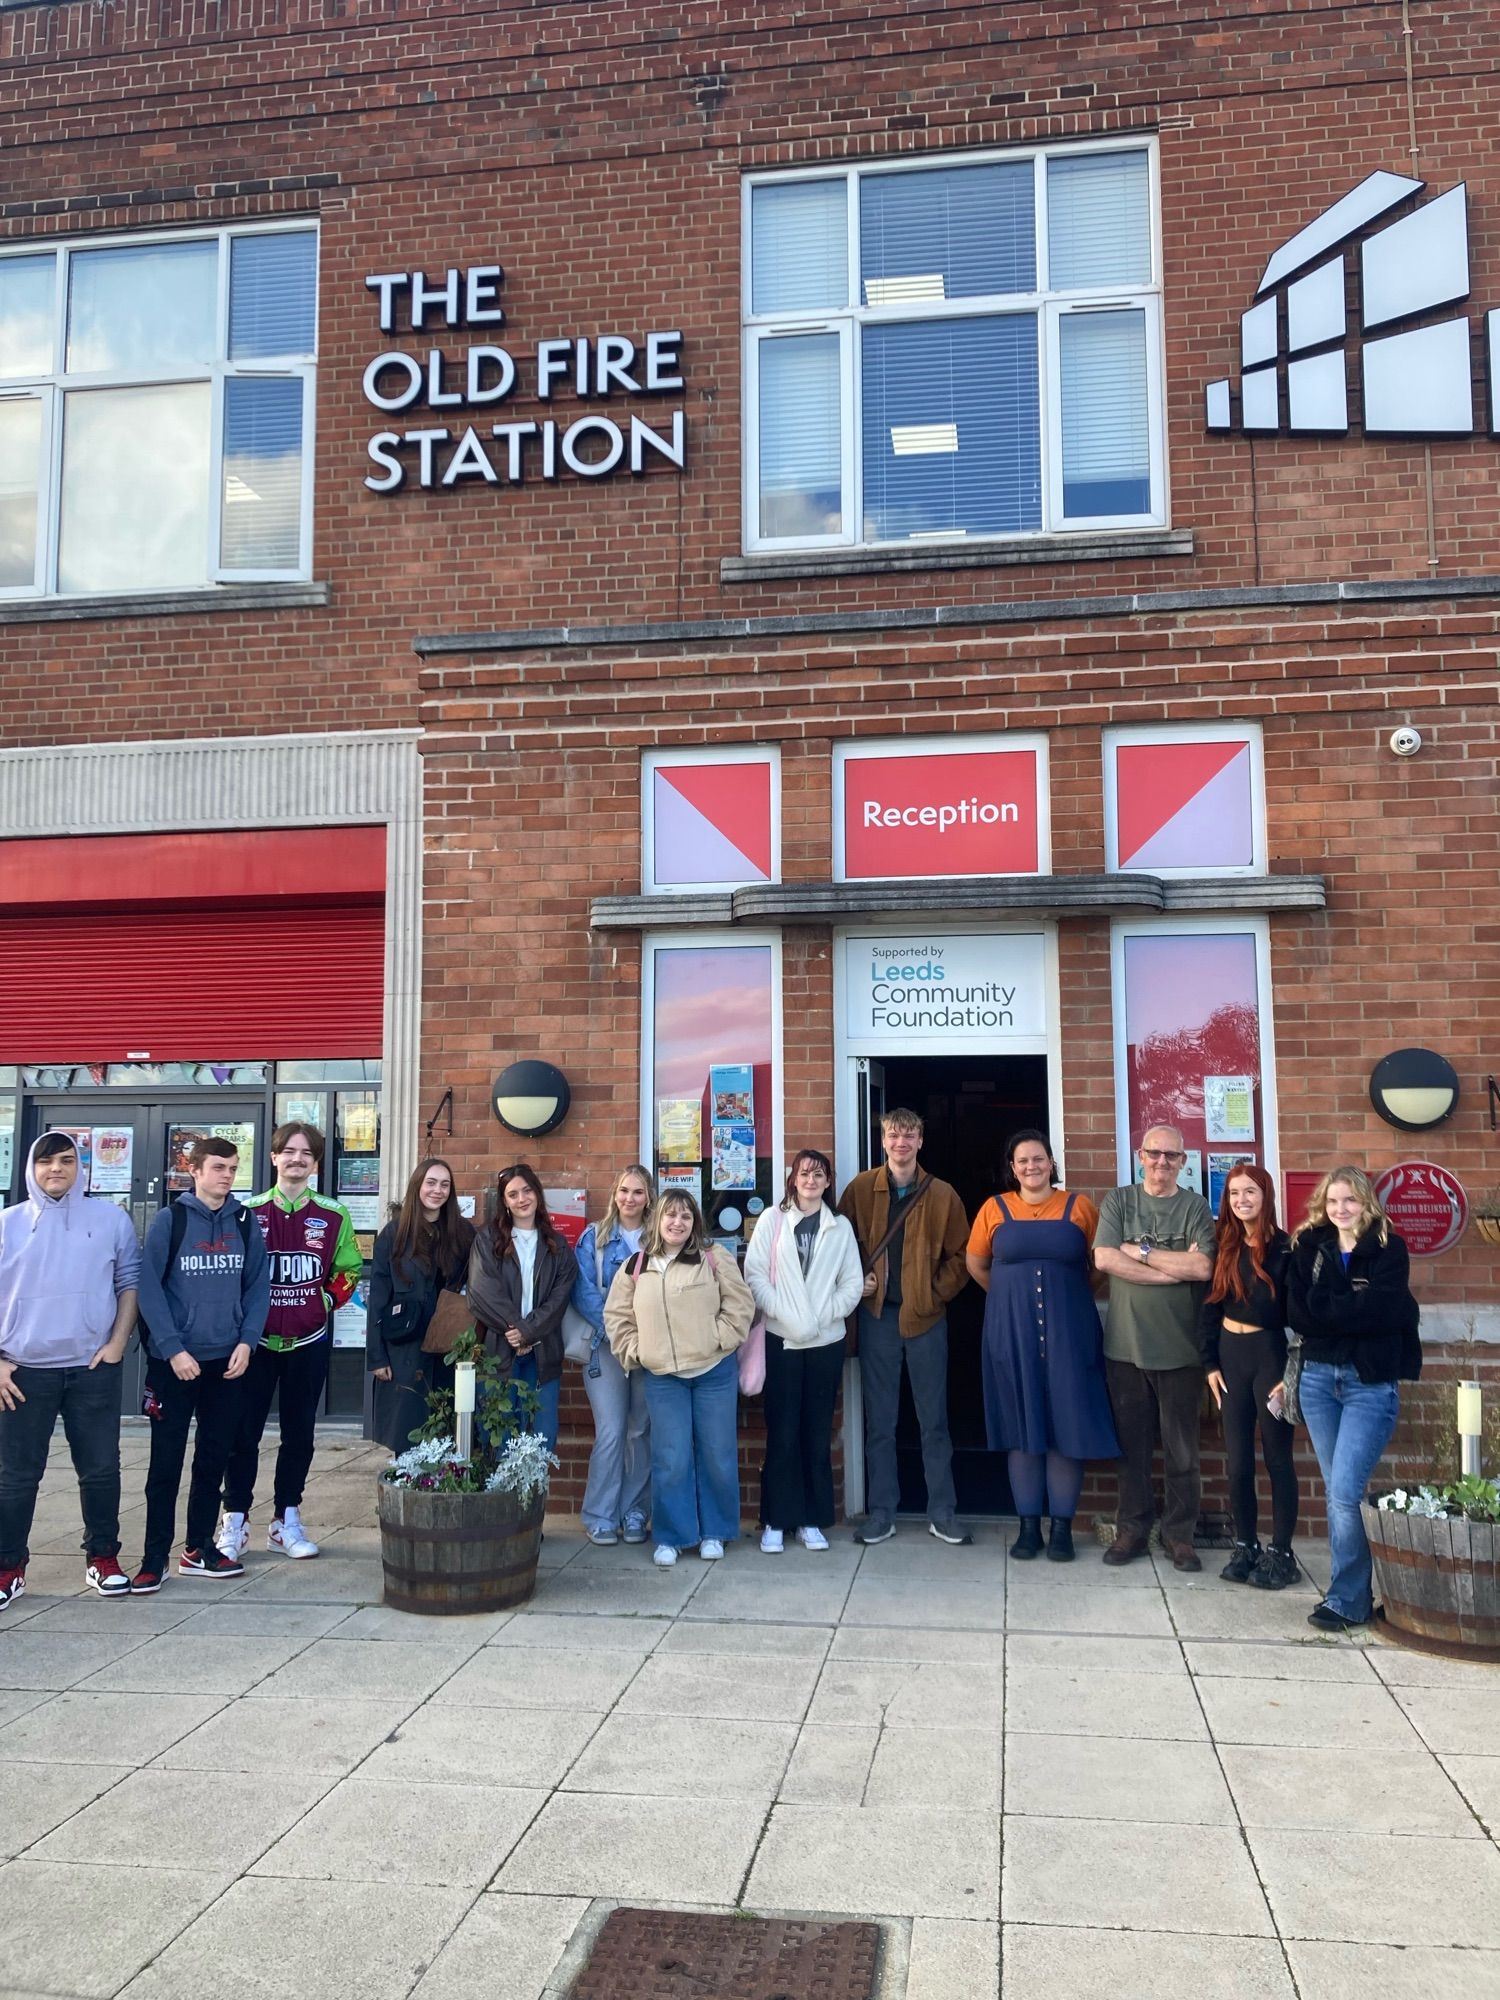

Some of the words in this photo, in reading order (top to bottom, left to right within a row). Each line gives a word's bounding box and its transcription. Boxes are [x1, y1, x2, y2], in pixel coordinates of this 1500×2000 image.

[365, 265, 505, 333] THE
[362, 346, 517, 413] OLD
[537, 331, 686, 400] FIRE
[363, 411, 686, 494] STATION
[863, 797, 1018, 832] Reception
[872, 946, 928, 959] Supported
[930, 946, 944, 959] by
[871, 961, 945, 982] Leeds
[872, 982, 1016, 1006] Community
[872, 1006, 1013, 1028] Foundation
[215, 1127, 239, 1135] CYCLE
[220, 1135, 247, 1143] PAIRS
[280, 1254, 321, 1283] PONT
[269, 1288, 317, 1298] TOMOTIVE
[270, 1297, 307, 1307] NISHES
